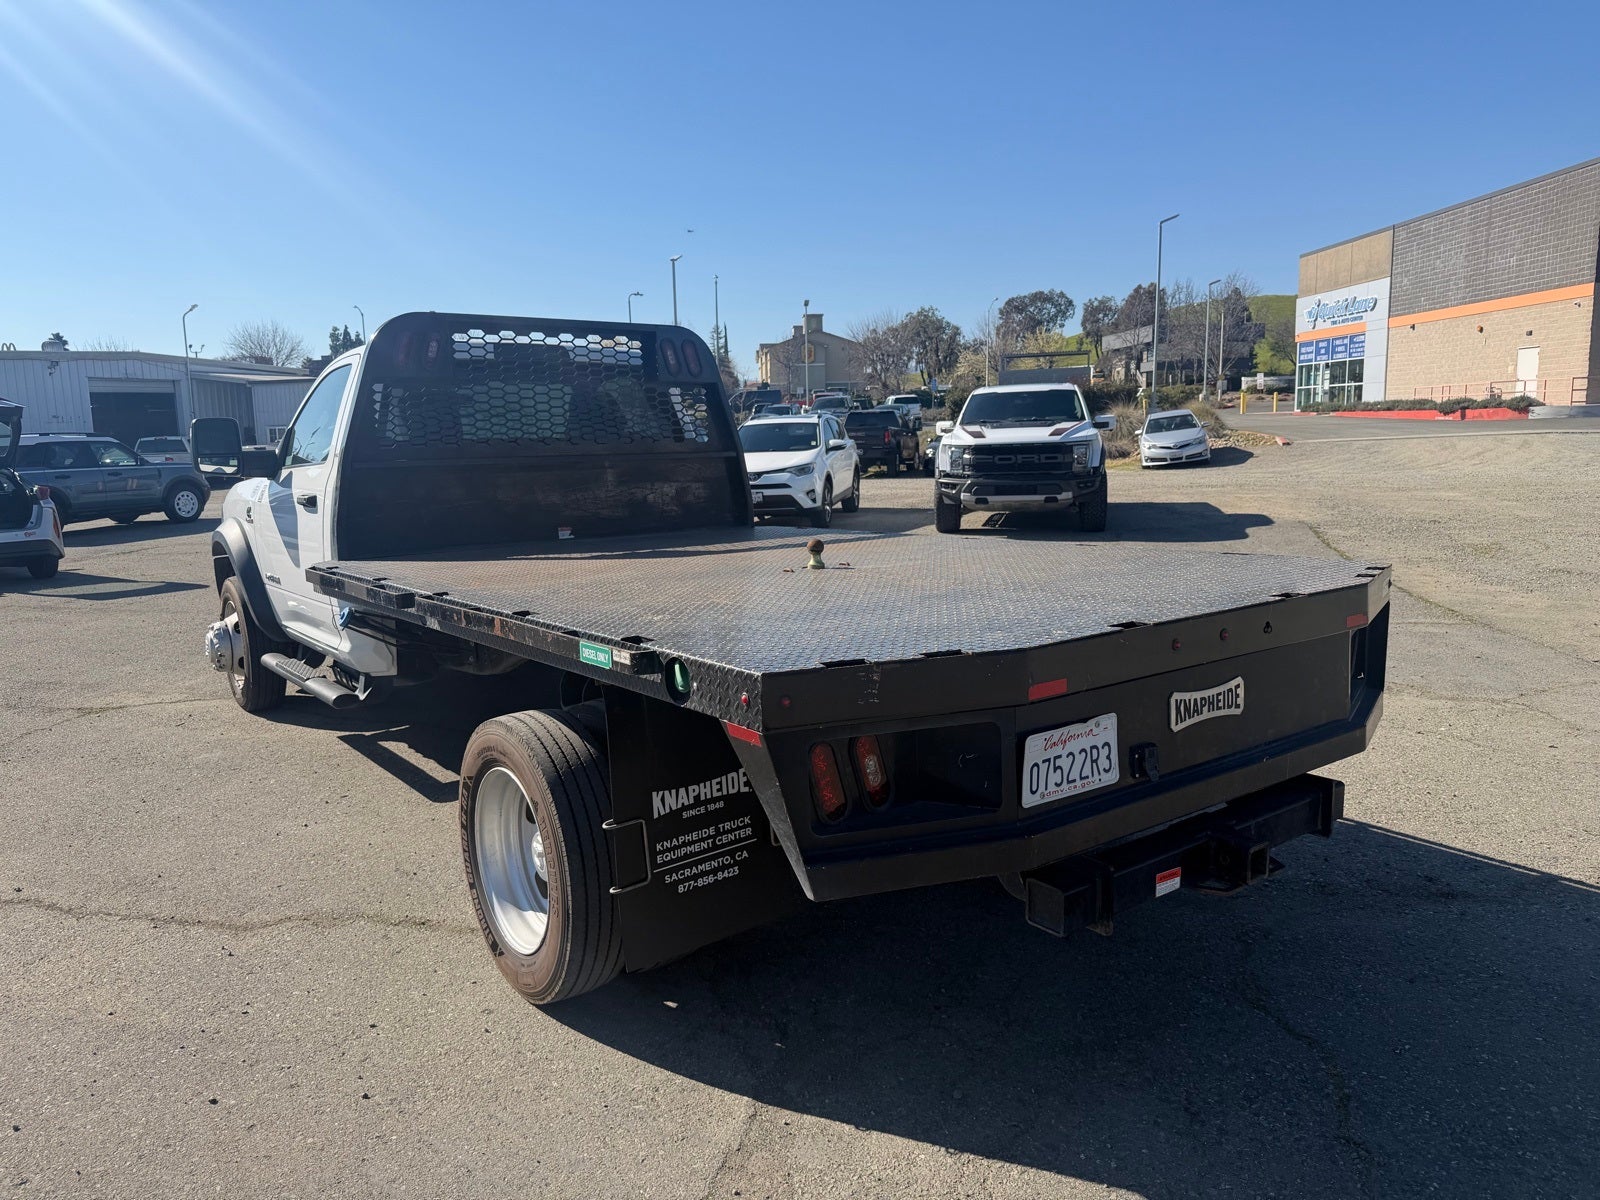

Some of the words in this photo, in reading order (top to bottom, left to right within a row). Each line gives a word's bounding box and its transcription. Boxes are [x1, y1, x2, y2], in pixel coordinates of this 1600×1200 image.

[1319, 299, 1348, 322] Quick
[1349, 295, 1377, 315] Lane
[974, 454, 1064, 464] FORD
[582, 647, 597, 660] DIESEL
[597, 651, 609, 663] ONLY
[1174, 683, 1241, 726] KNAPHEIDE
[1044, 728, 1099, 751] California
[1029, 741, 1113, 795] 07522R3
[652, 768, 750, 819] KNAPHEIDE
[1045, 779, 1097, 799] dmv.ca.gov
[682, 806, 706, 819] SINCE
[707, 801, 724, 811] 1848
[656, 826, 716, 852] KNAPHEIDE
[718, 816, 751, 832] TRUCK
[657, 839, 713, 864] EQUIPMENT
[716, 827, 752, 845] CENTER
[461, 832, 474, 884] GUARD
[665, 856, 734, 883] SACRAMENTO,
[735, 850, 749, 860] CA
[678, 866, 739, 893] 877-856-8423
[472, 888, 494, 945] STRONG
